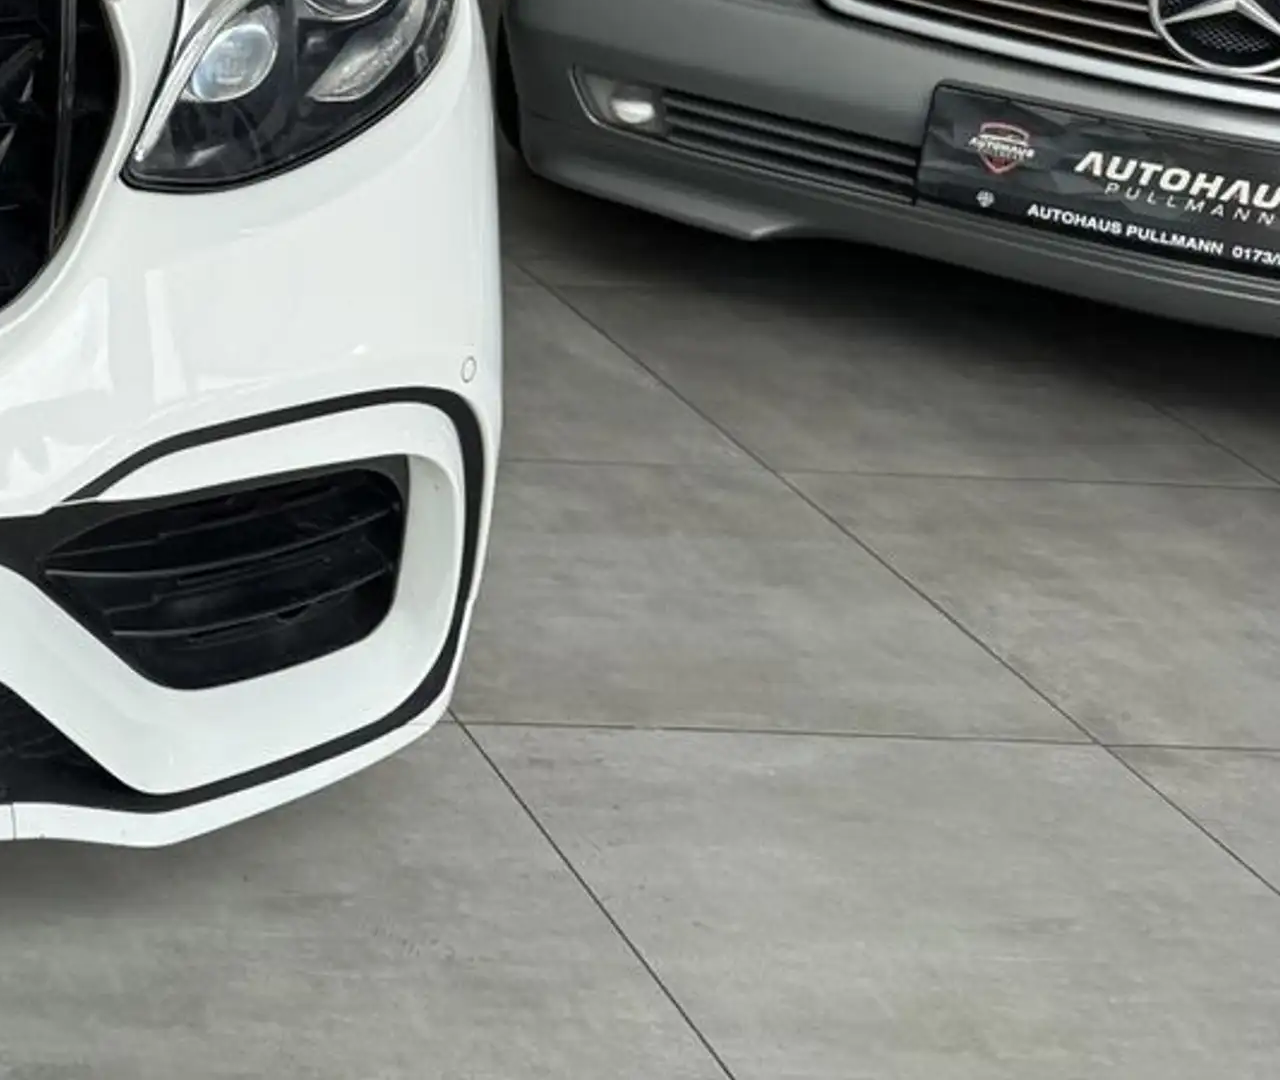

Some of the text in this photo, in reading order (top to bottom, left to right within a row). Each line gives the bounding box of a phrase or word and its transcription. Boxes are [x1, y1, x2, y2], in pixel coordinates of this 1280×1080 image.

[1104, 182, 1276, 227] PULLMANN
[1026, 203, 1123, 236] AUTOHAUS
[1125, 224, 1225, 256] PULLMANN
